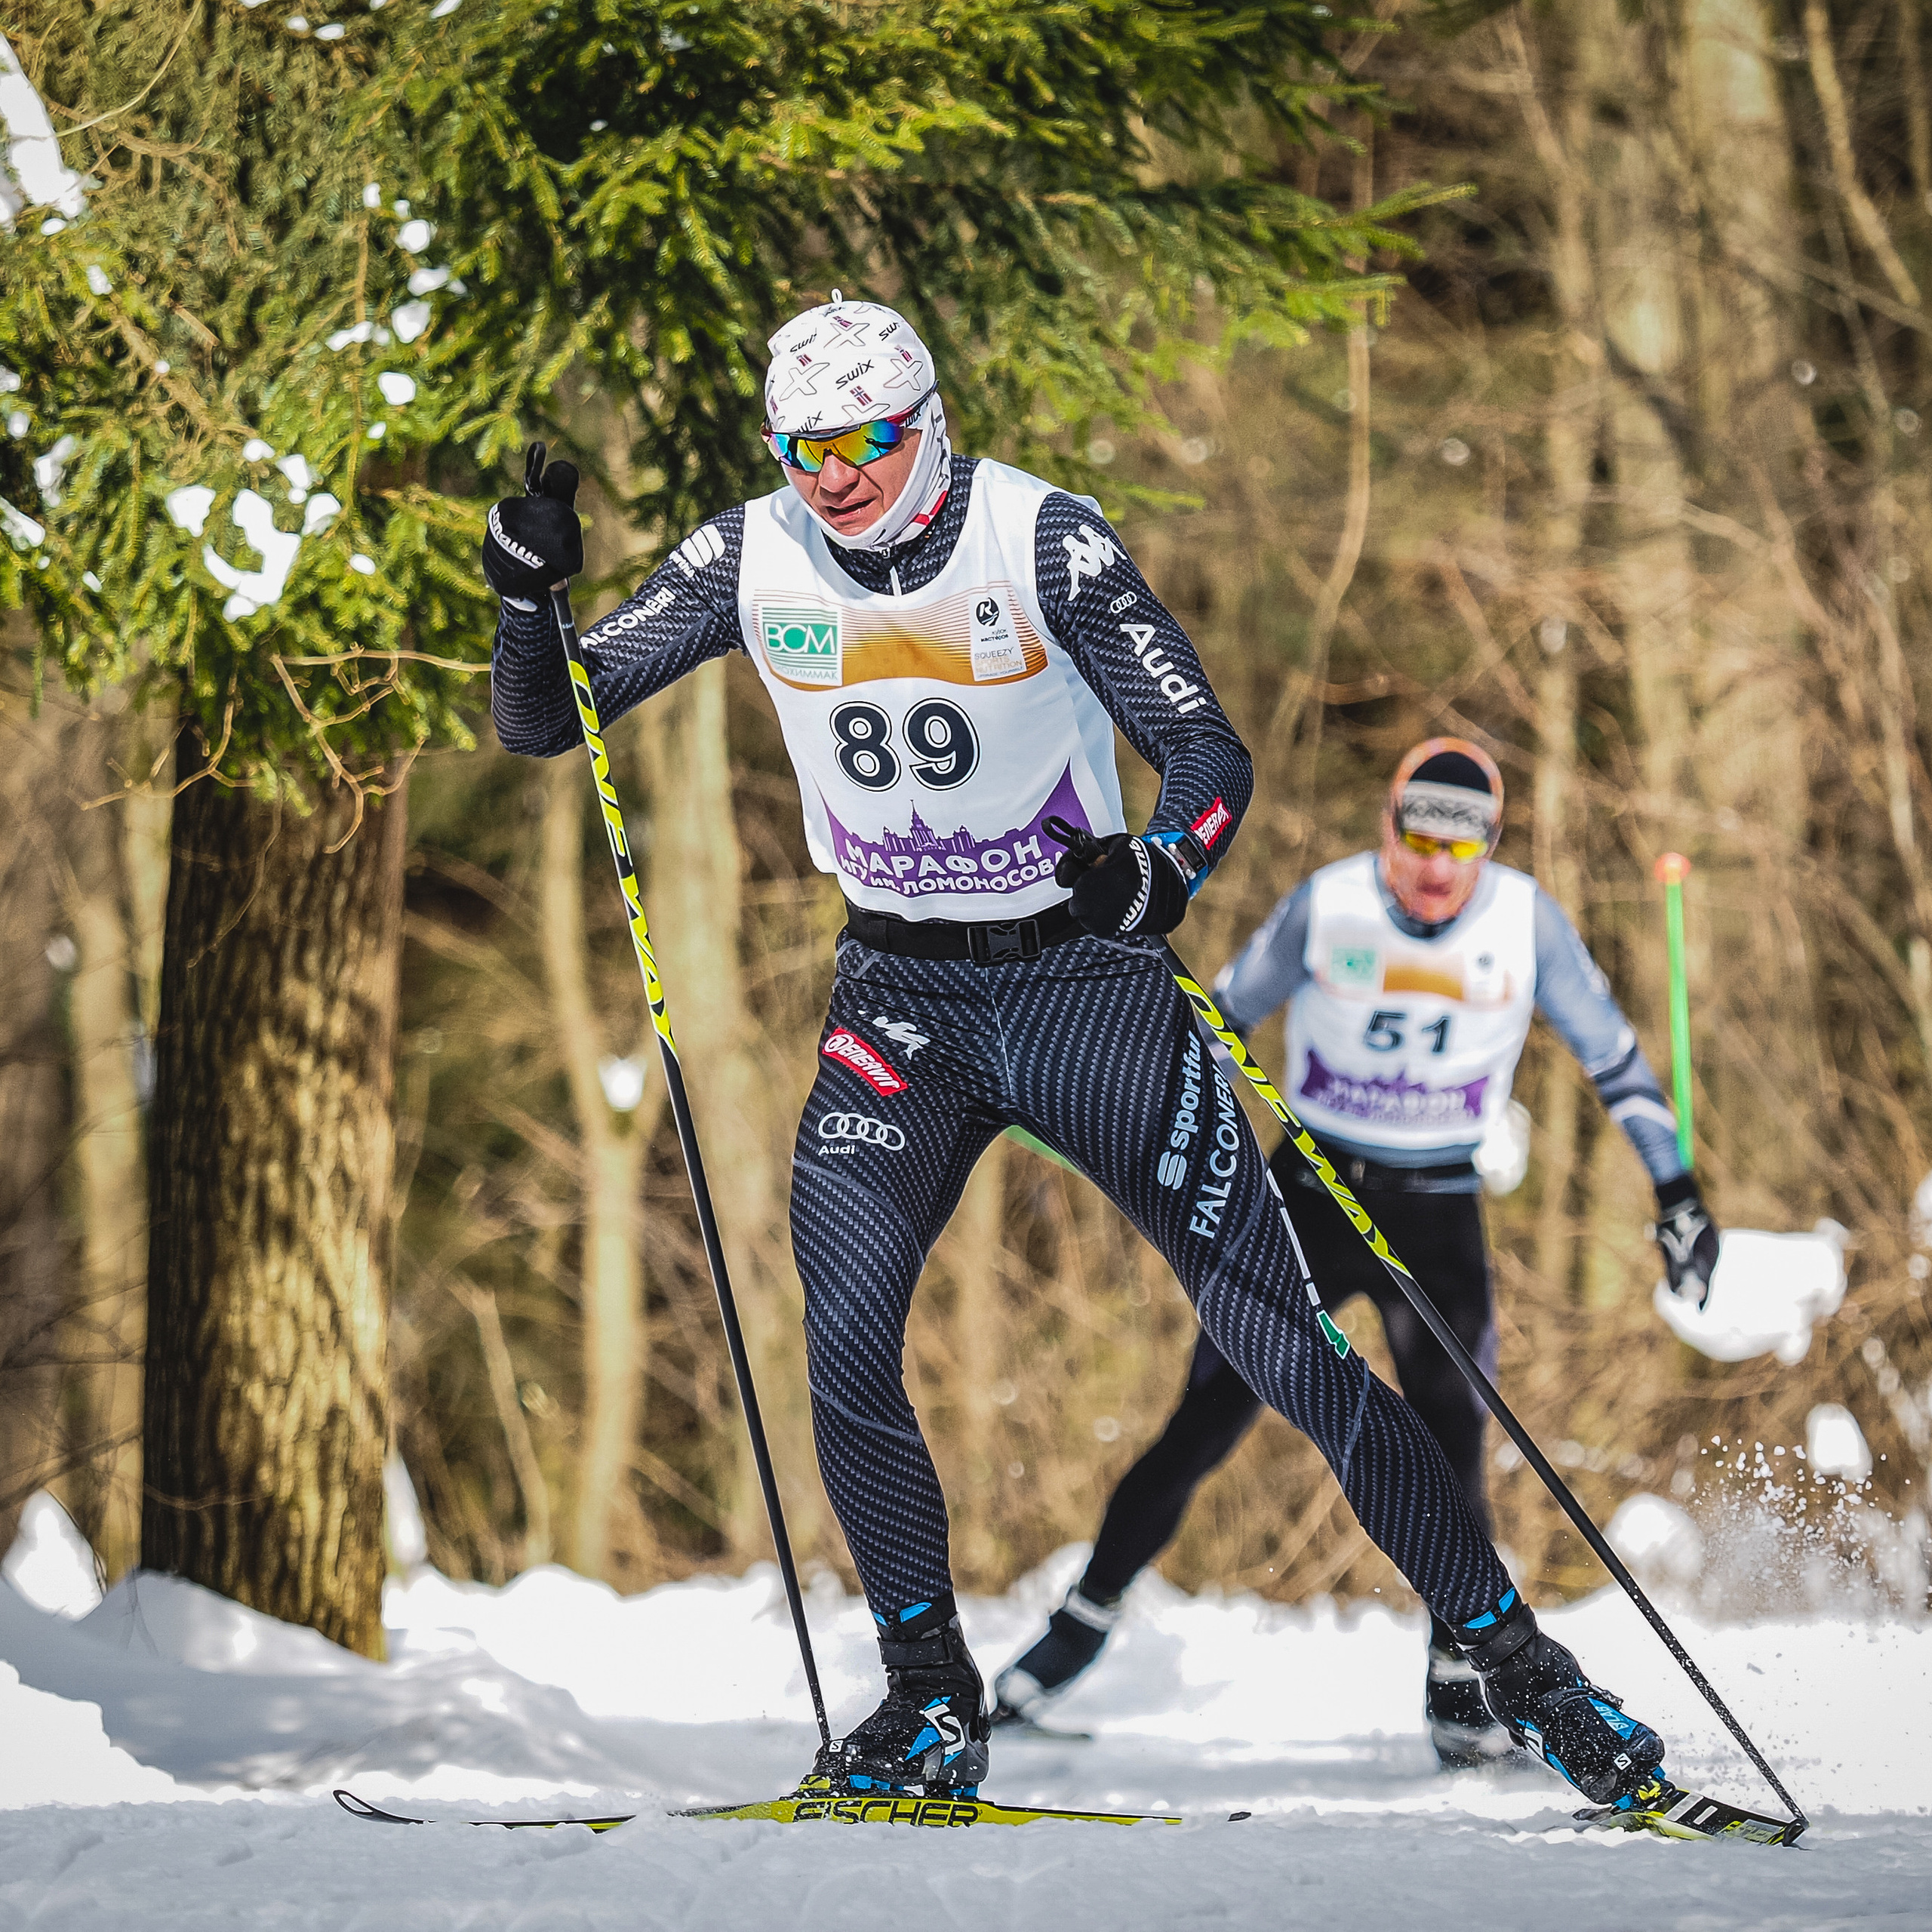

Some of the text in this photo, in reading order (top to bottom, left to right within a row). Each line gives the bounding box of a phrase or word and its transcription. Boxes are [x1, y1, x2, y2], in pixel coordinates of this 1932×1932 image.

[835, 359, 875, 389] swix
[795, 411, 823, 432] wix
[900, 408, 921, 428] wix
[580, 586, 676, 649] ALCONERI
[974, 647, 1014, 660] SQUEEZY
[1119, 623, 1207, 714] Audi
[829, 697, 981, 792] 89
[844, 835, 1043, 879] МАРАФОН
[1364, 1009, 1454, 1054] 51
[838, 1043, 900, 1089] ENERVIT
[1170, 1029, 1201, 1151] sportful
[818, 1145, 856, 1156] Audi
[1189, 1063, 1239, 1239] FALCONERI
[792, 1800, 979, 1827] FISCHER
